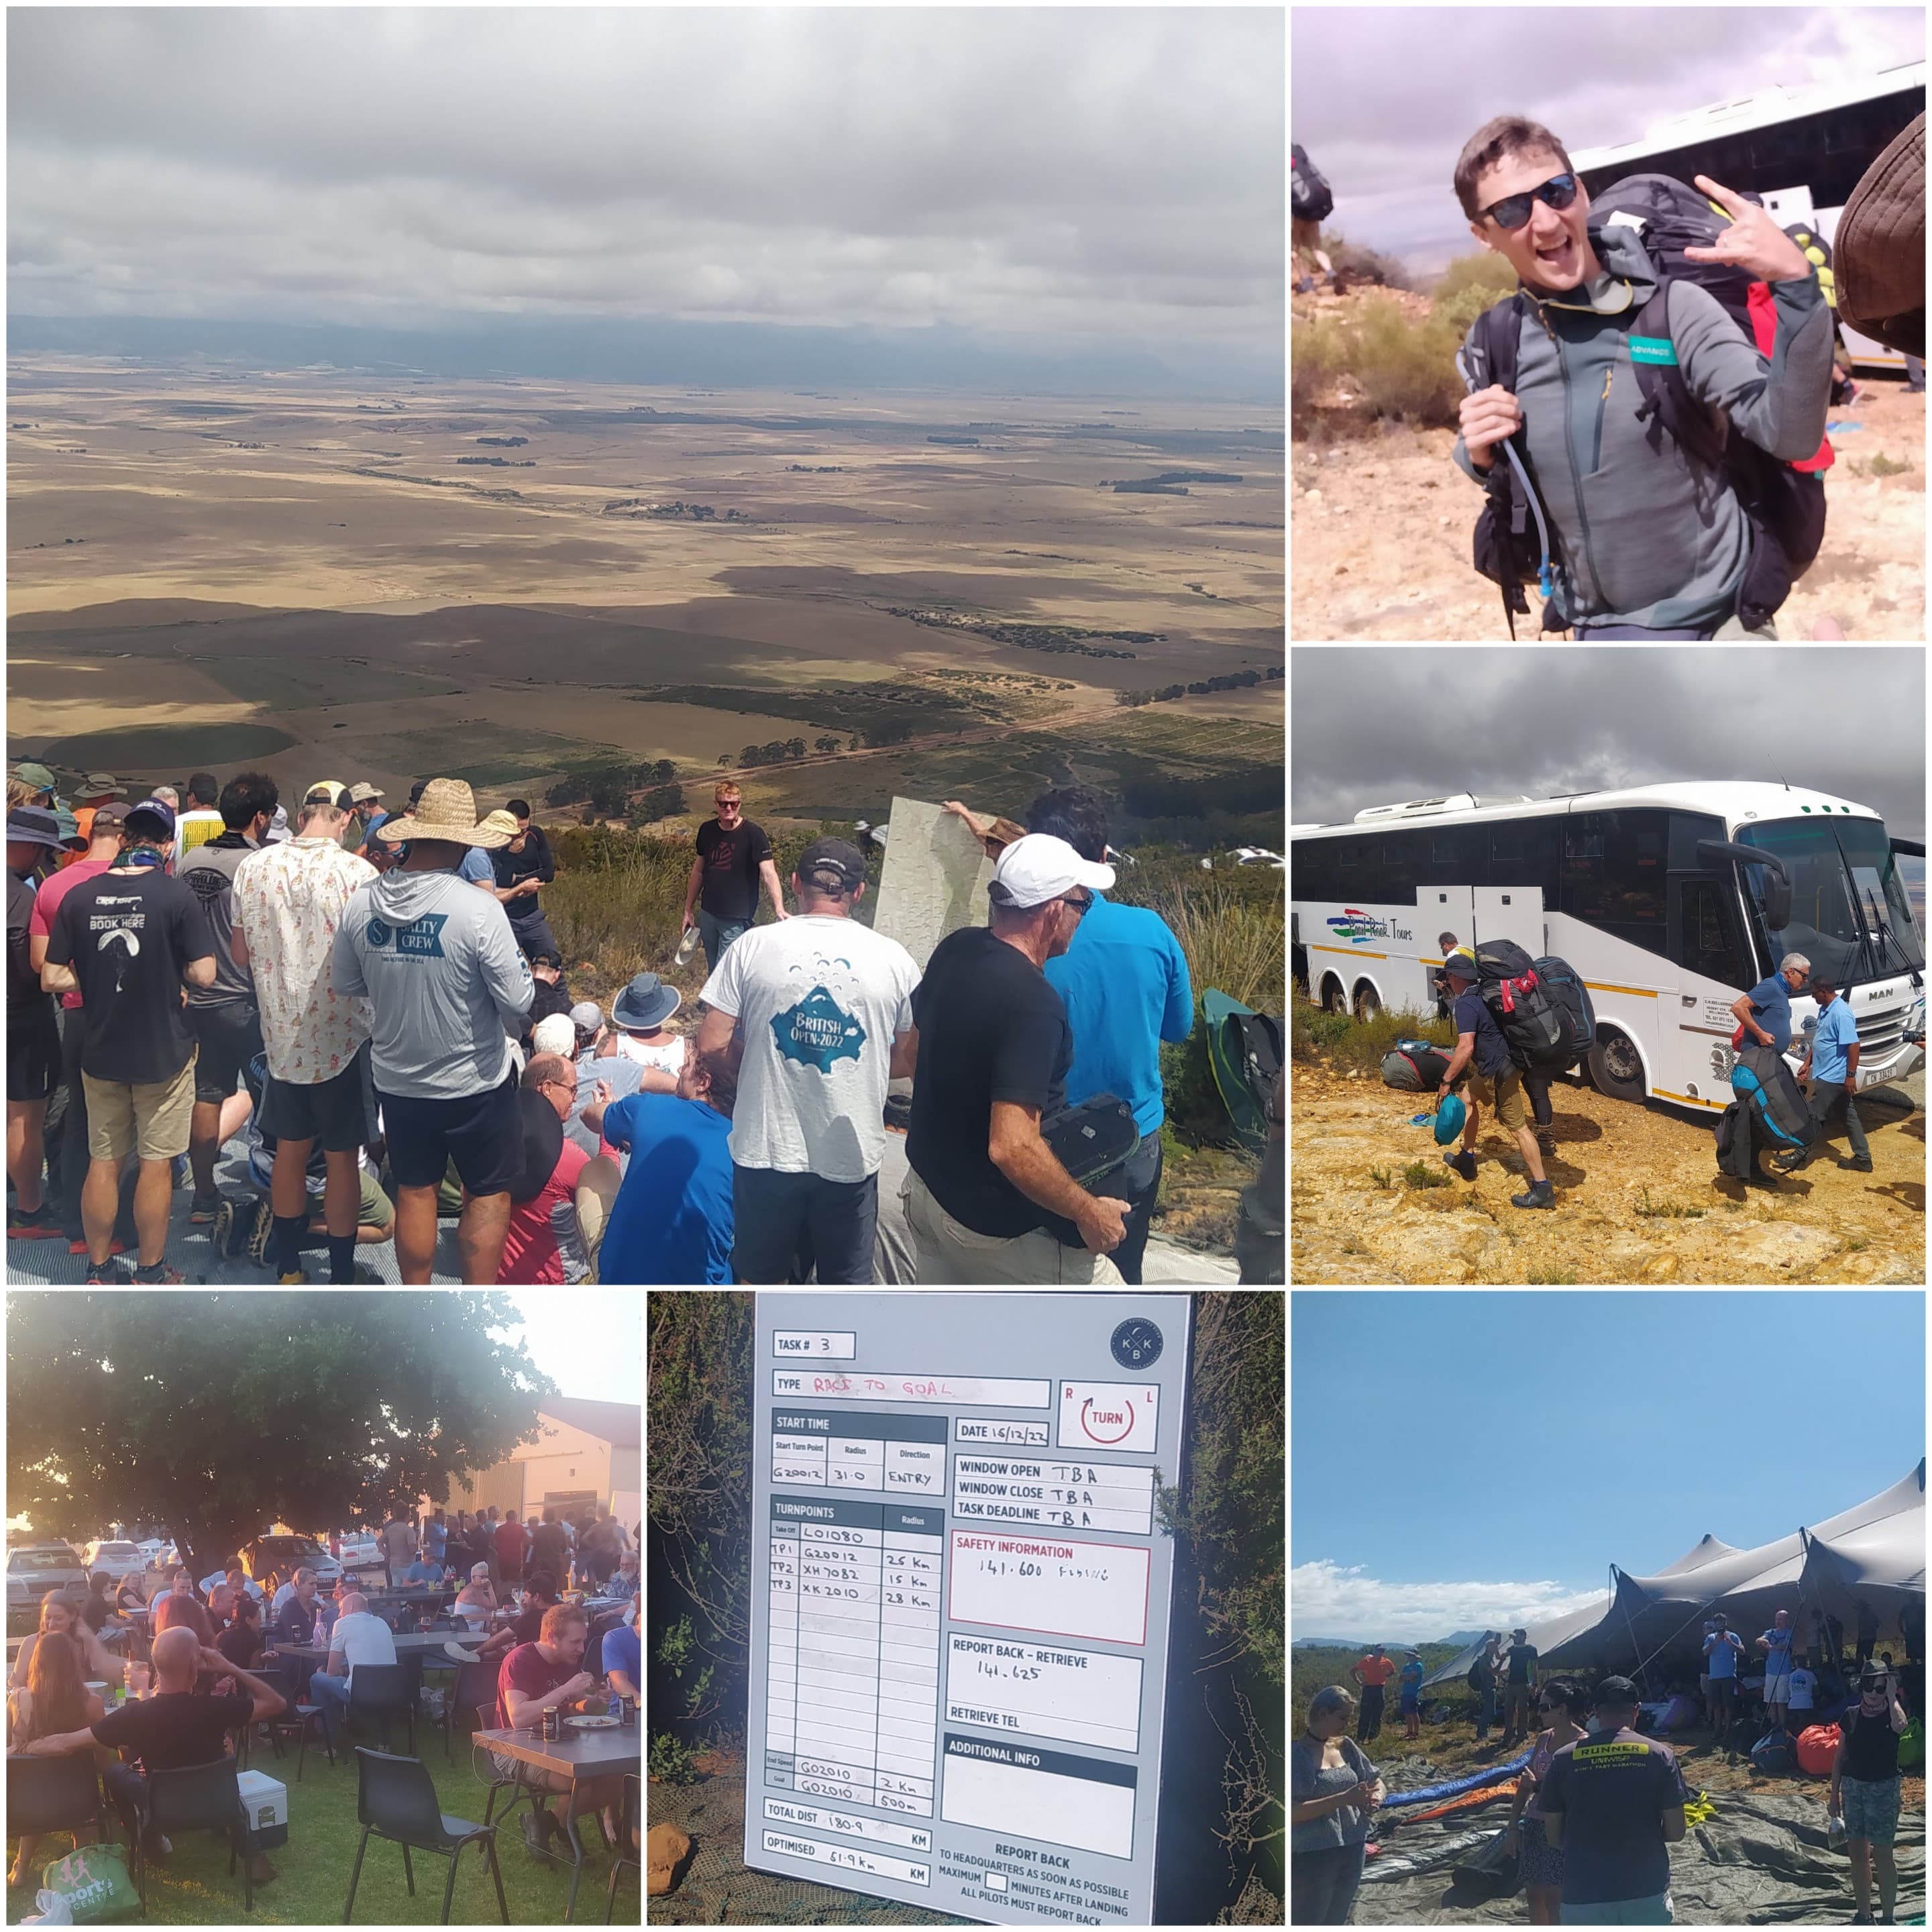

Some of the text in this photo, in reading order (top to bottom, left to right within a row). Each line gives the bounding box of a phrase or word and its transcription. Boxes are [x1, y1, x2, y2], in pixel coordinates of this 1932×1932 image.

[1631, 345, 1670, 357] ADVANCE
[90, 918, 145, 930] BOOK HERE
[1390, 918, 1412, 941] Tours
[401, 934, 435, 950] CREW
[1869, 988, 1893, 1001] MAN
[796, 1012, 841, 1034] BRITISH
[778, 1338, 830, 1350] TASK # 3
[1122, 1339, 1152, 1349] K K
[1132, 1350, 1140, 1360] B
[778, 1377, 952, 1396] TYPE RACE TO GOAL
[1065, 1387, 1073, 1399] R
[1146, 1391, 1153, 1403] L
[777, 1416, 830, 1430] START TIME
[1092, 1411, 1124, 1424] TURN
[961, 1425, 988, 1438] DATE
[775, 1442, 824, 1452] Start Turn Point
[845, 1446, 867, 1455] Radius
[900, 1450, 930, 1459] Direction
[960, 1460, 1097, 1483] WINDOW OPEN TBA
[888, 1471, 931, 1487] ENTRY
[959, 1482, 1093, 1505] WINDOW CLOSE TBA
[775, 1503, 835, 1519] TURNPOINTS
[959, 1502, 1091, 1526] TASK DEADLINE TBA
[902, 1515, 925, 1525] Radius
[775, 1525, 787, 1534] Take
[771, 1544, 792, 1554] TP1
[957, 1537, 1074, 1560] SAFETY INFORMATION
[886, 1555, 906, 1566] 25
[771, 1562, 794, 1574] TP2
[771, 1580, 792, 1591] TP3
[890, 1575, 903, 1584] 15
[885, 1593, 904, 1604] 28
[953, 1639, 994, 1656] REPORT
[996, 1645, 1024, 1660] BACK
[1036, 1651, 1088, 1669] RETRIEVE
[951, 1706, 1020, 1729] RETRIEVE TEL
[949, 1739, 1040, 1767] ADDITIONAL INFO
[1581, 1745, 1640, 1756] RUNNER
[777, 1758, 793, 1766] Speed
[773, 1775, 786, 1783] Goal
[881, 1778, 893, 1788] 2
[768, 1804, 796, 1819] TOTAL
[798, 1811, 818, 1823] DIST
[912, 1833, 927, 1847] KM
[767, 1837, 816, 1856] OPTIMISED
[910, 1868, 925, 1881] KM
[995, 1843, 1071, 1870] REPORT BACK
[940, 1848, 1130, 1900] TO HEADQUARTERS AS SOON AS POSSIBLE
[938, 1864, 1129, 1917] MAXIMUM MINUTES AFTER LANDING
[961, 1886, 1103, 1926] ALL PILOTS MUST REPORT BACK
